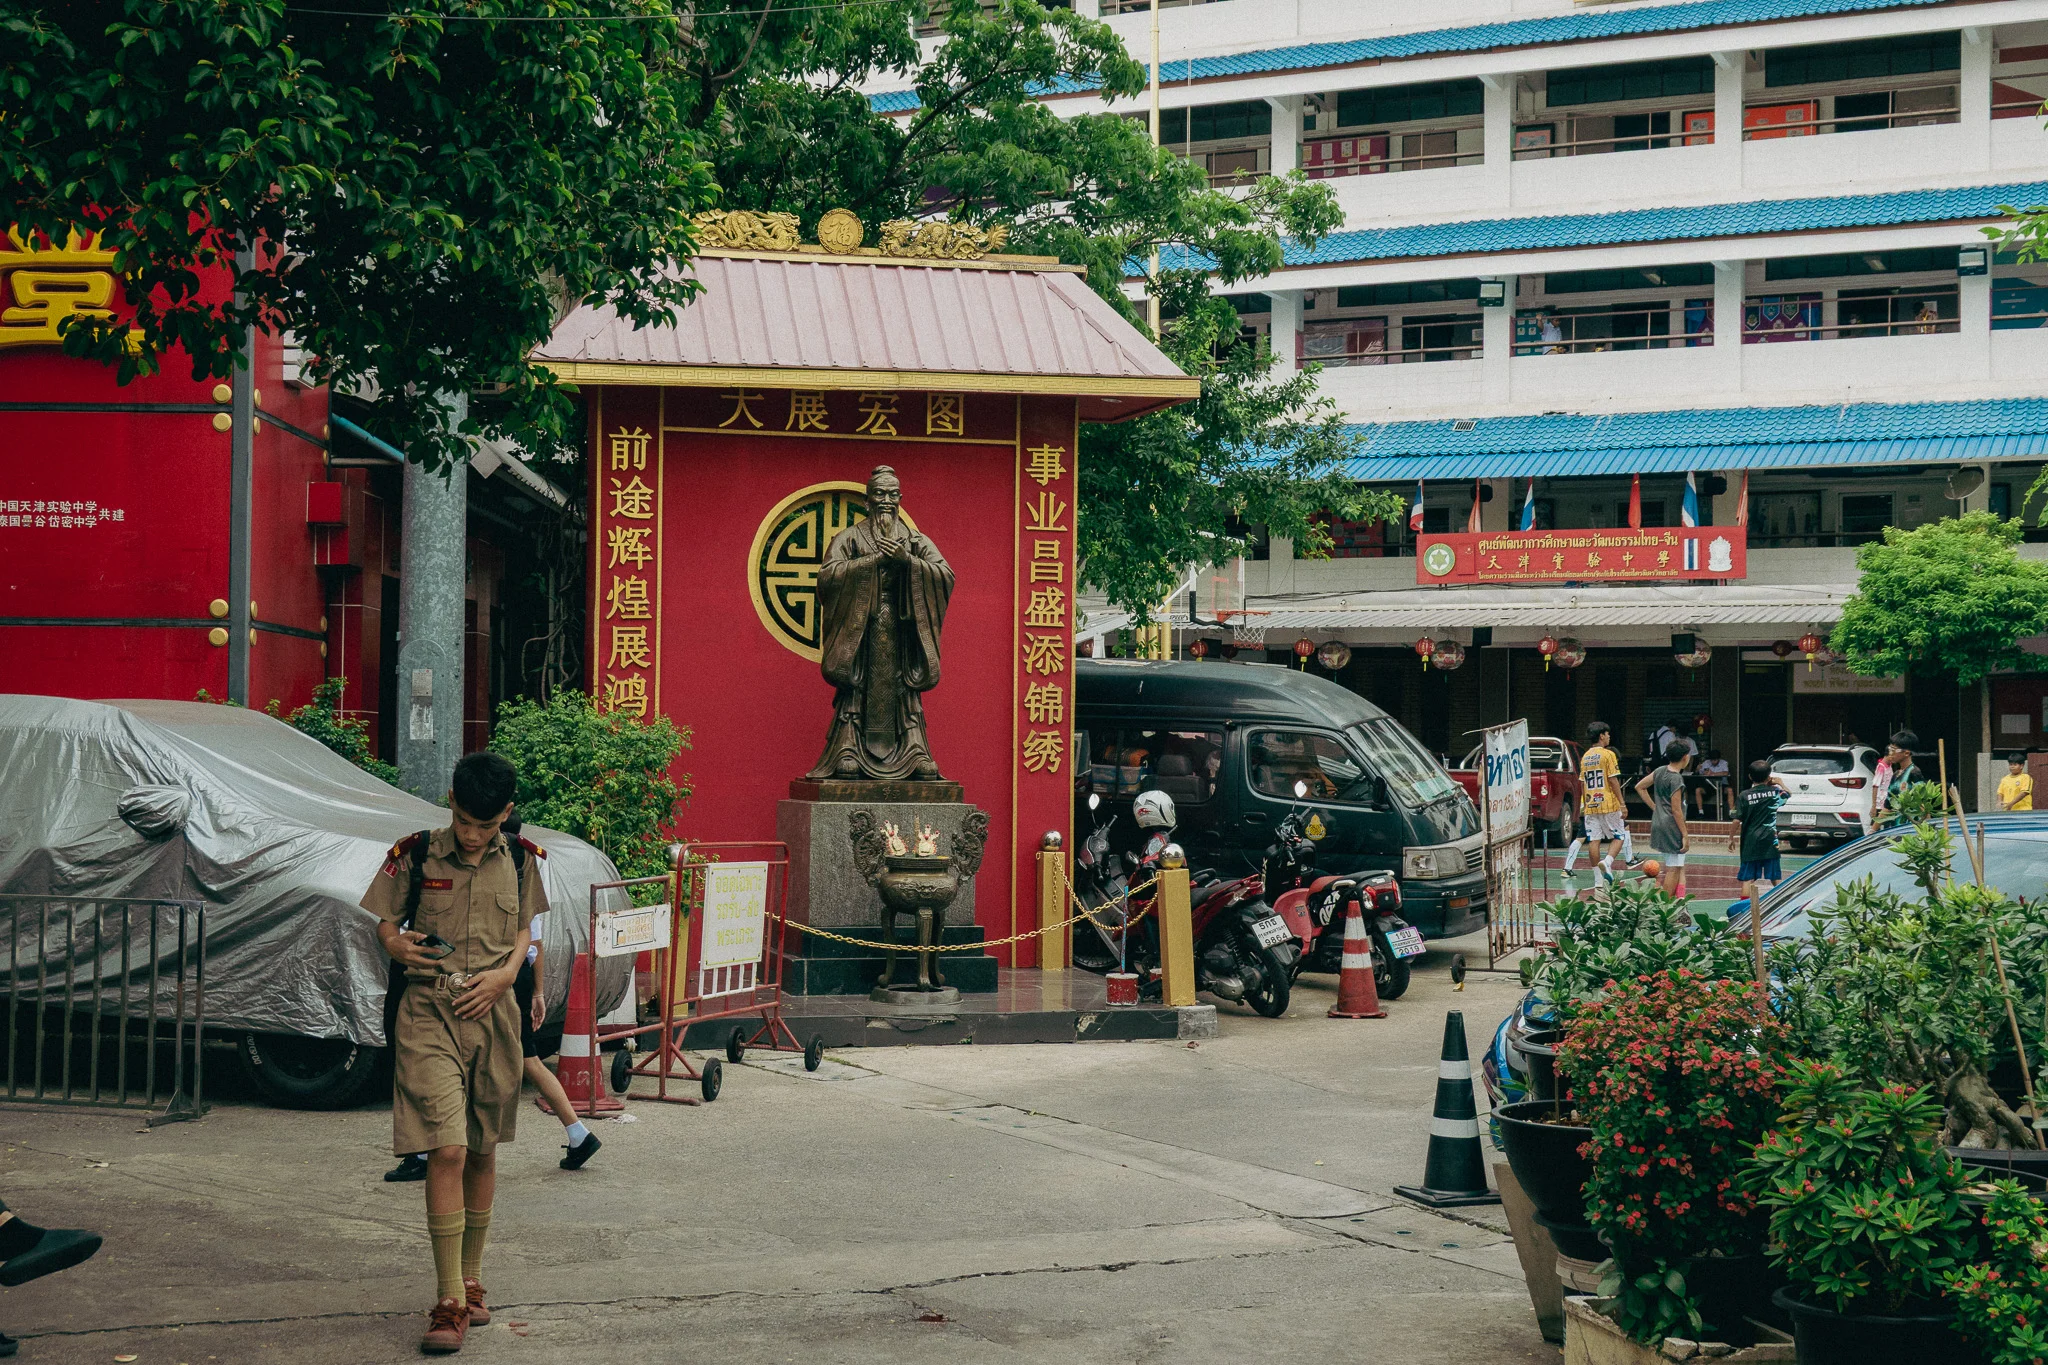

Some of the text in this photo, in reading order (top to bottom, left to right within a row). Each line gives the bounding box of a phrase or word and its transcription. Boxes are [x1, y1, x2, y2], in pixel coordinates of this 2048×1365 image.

[719, 388, 964, 436] 大展宏图
[0, 499, 97, 513] 中国天津实验中学
[99, 508, 125, 522] 共建
[1022, 443, 1068, 773] 事业昌盛添锦绣
[1264, 932, 1288, 946] 9864
[1399, 945, 1420, 955] 2019
